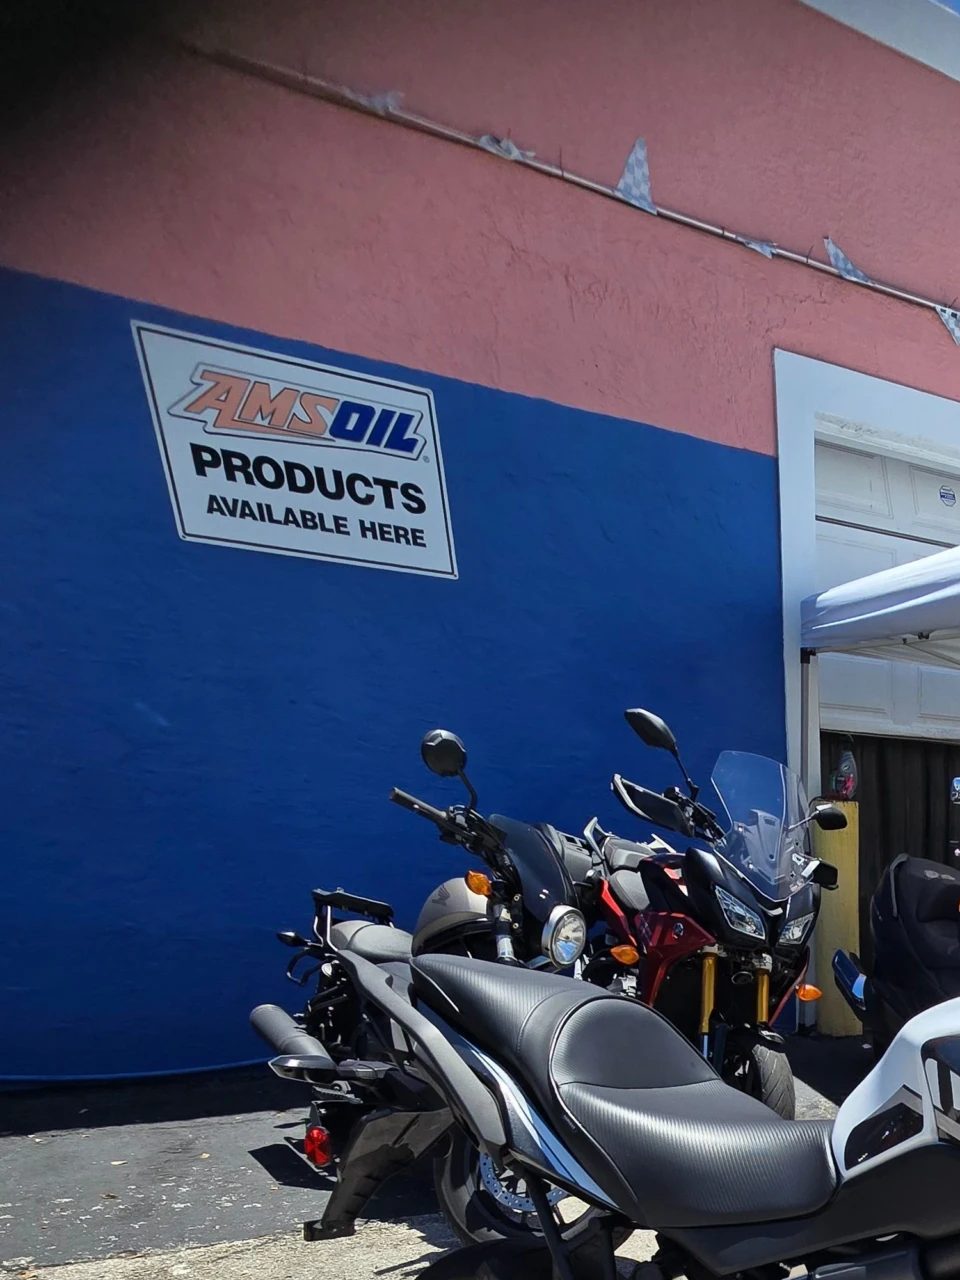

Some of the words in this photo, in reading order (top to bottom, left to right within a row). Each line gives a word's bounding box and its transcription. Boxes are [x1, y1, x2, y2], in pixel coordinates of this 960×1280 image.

[184, 369, 420, 453] AMSOIL
[189, 442, 427, 515] PRODUCTS
[206, 494, 351, 537] AVAILABLE
[359, 519, 427, 548] HERE
